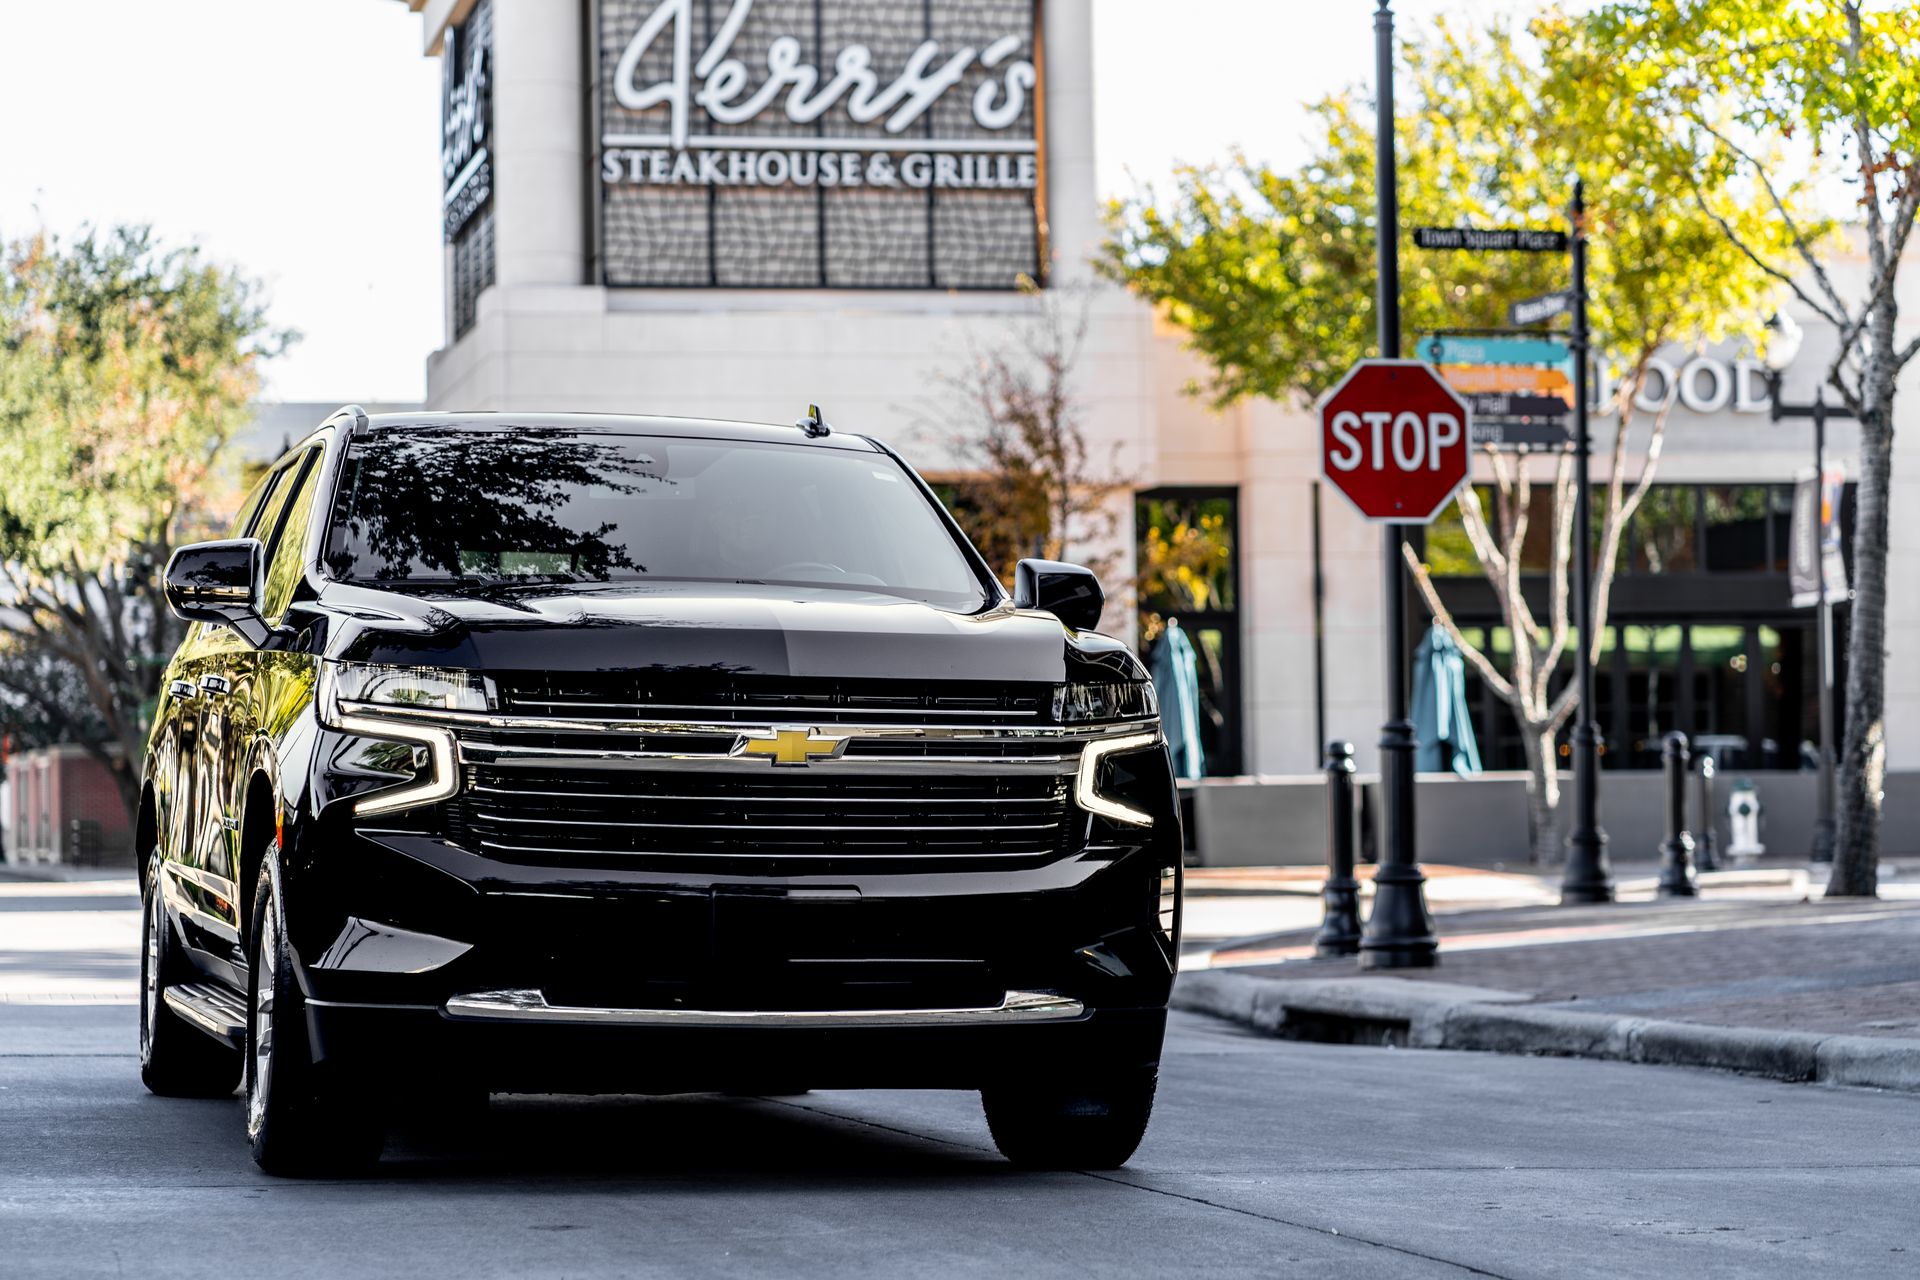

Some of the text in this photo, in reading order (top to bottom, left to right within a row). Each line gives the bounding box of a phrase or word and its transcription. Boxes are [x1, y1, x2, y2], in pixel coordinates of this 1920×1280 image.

[602, 149, 1038, 188] STEAKHOUSE & GRILLE
[1421, 228, 1462, 248] Town
[1465, 229, 1514, 249] Square
[1330, 410, 1461, 472] STOP
